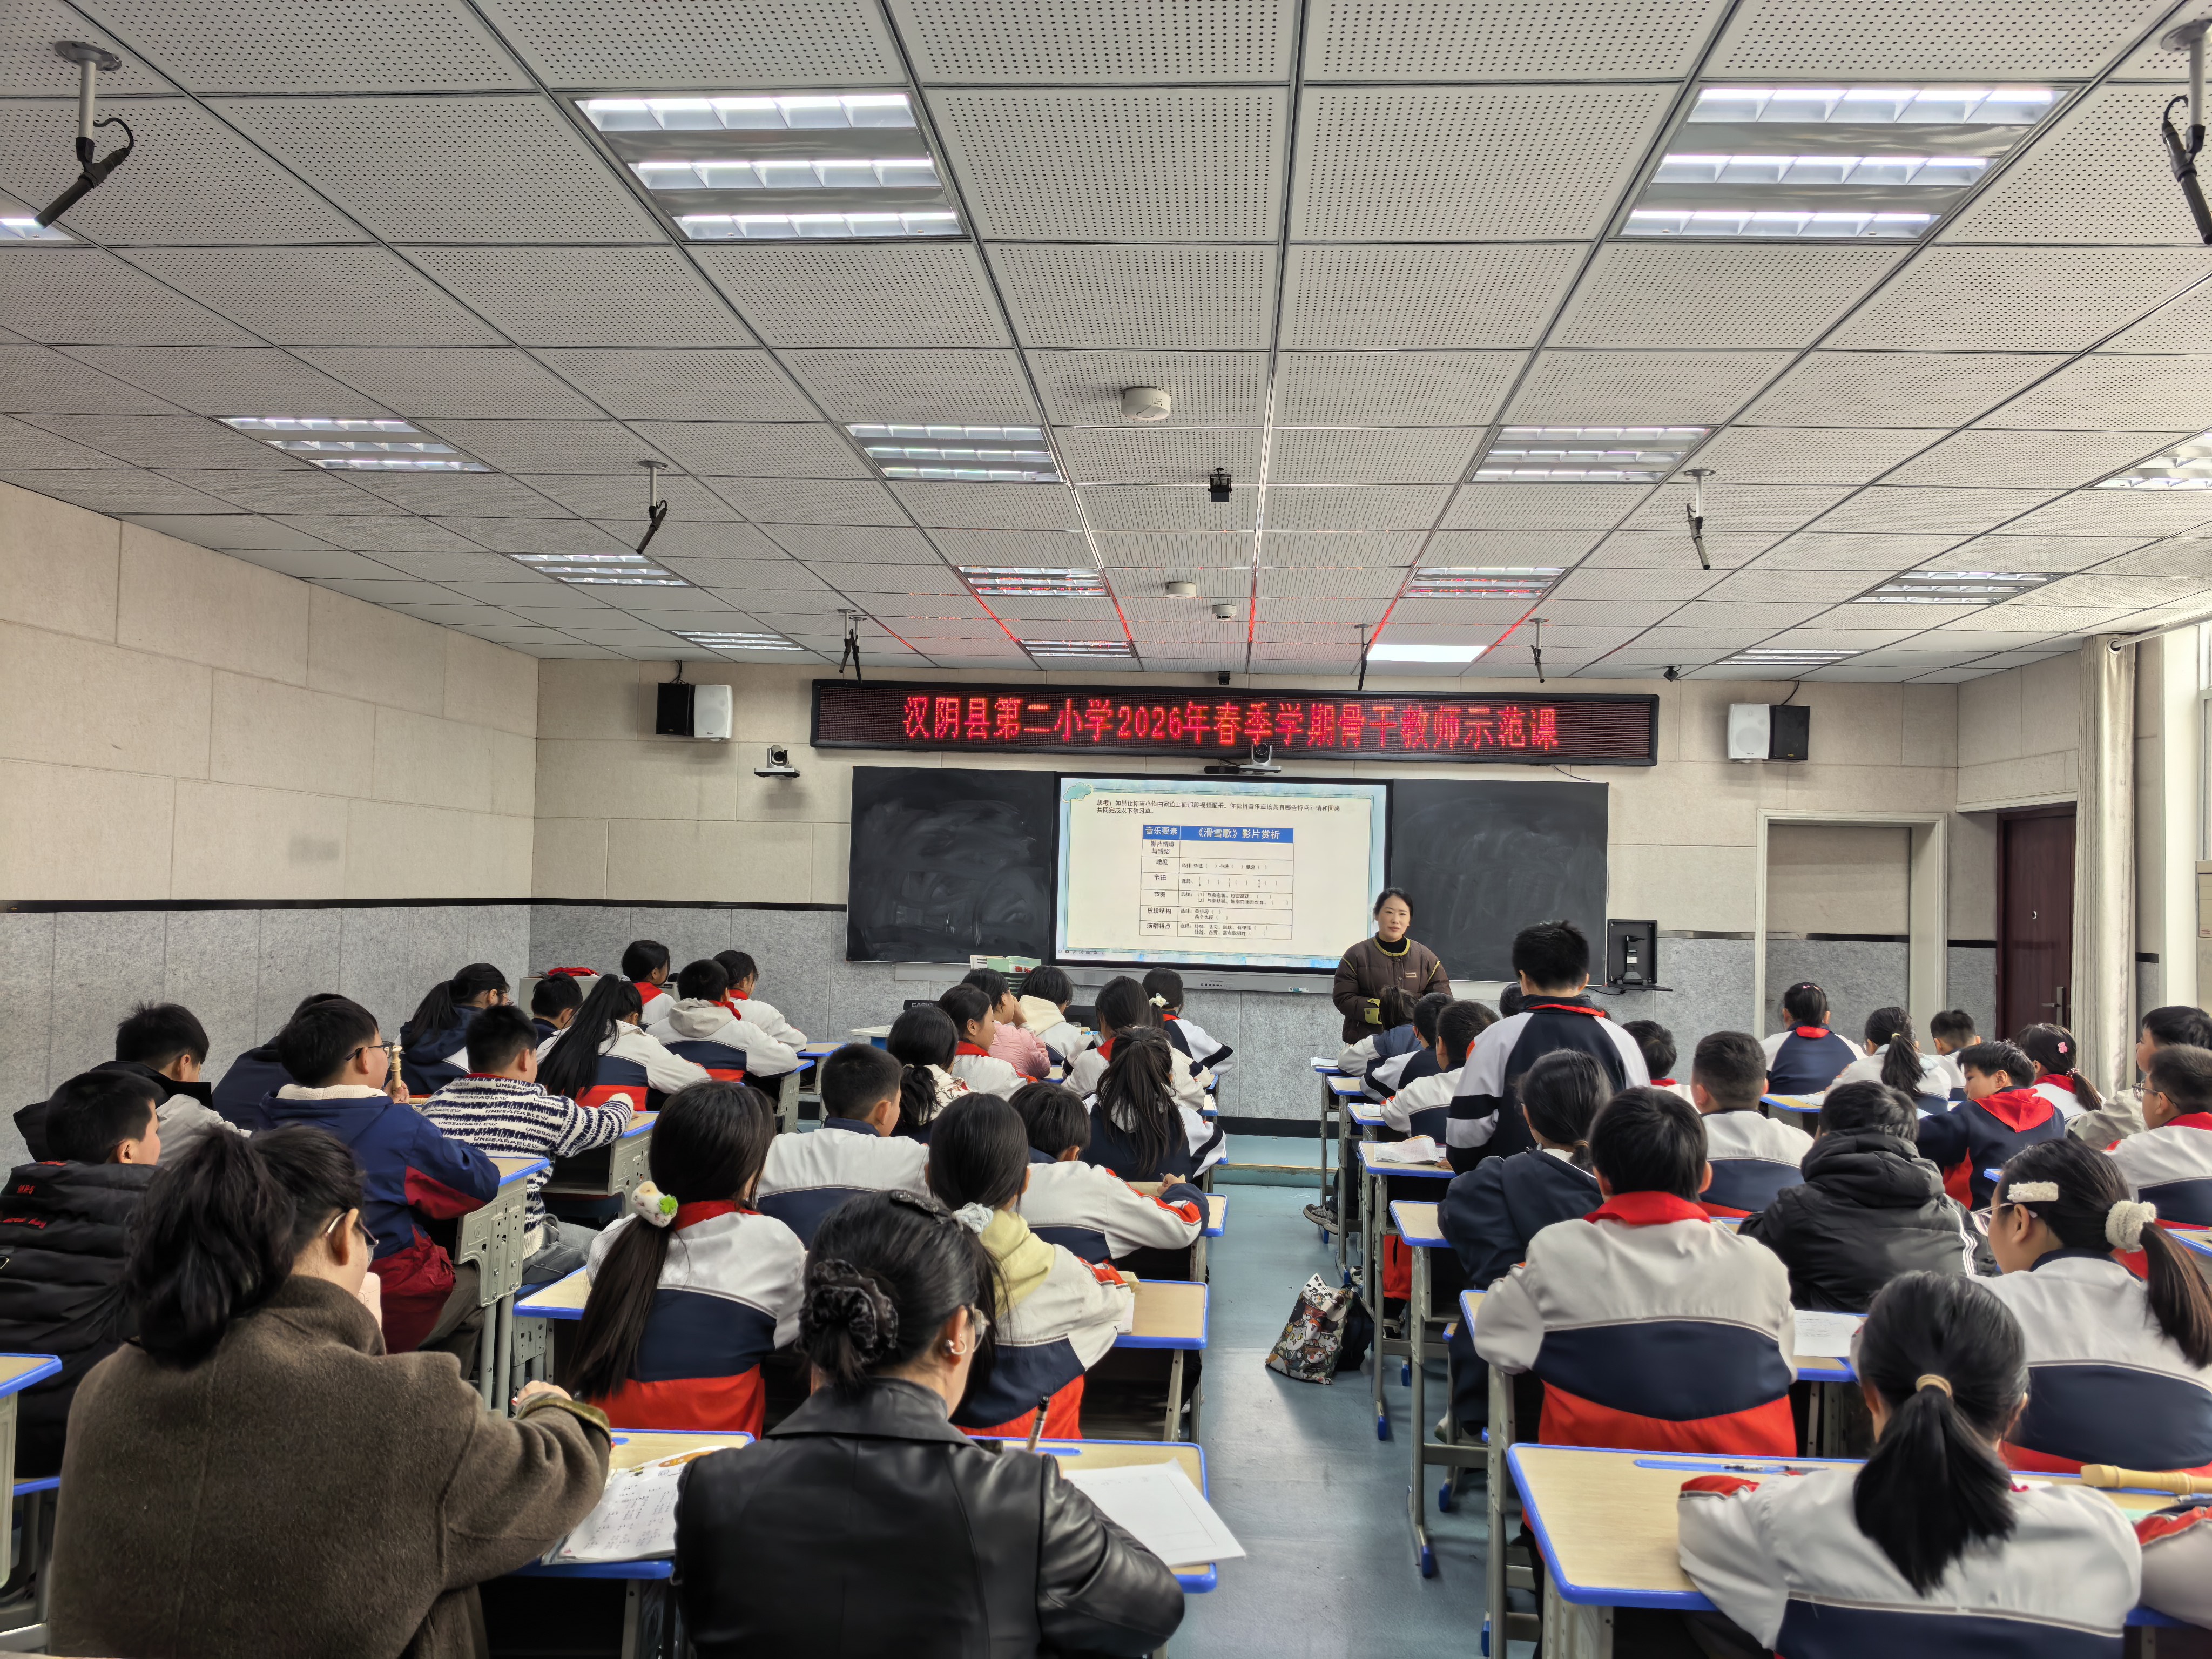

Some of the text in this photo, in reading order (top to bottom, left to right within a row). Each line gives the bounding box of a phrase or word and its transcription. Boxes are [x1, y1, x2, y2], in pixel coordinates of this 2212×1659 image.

[903, 696, 1559, 751] 汉阴县第二小学2026年春季学期骨干教师示范课
[1145, 826, 1178, 835] 音乐要素
[1198, 827, 1280, 840] 《滑雪歌》影片赏析
